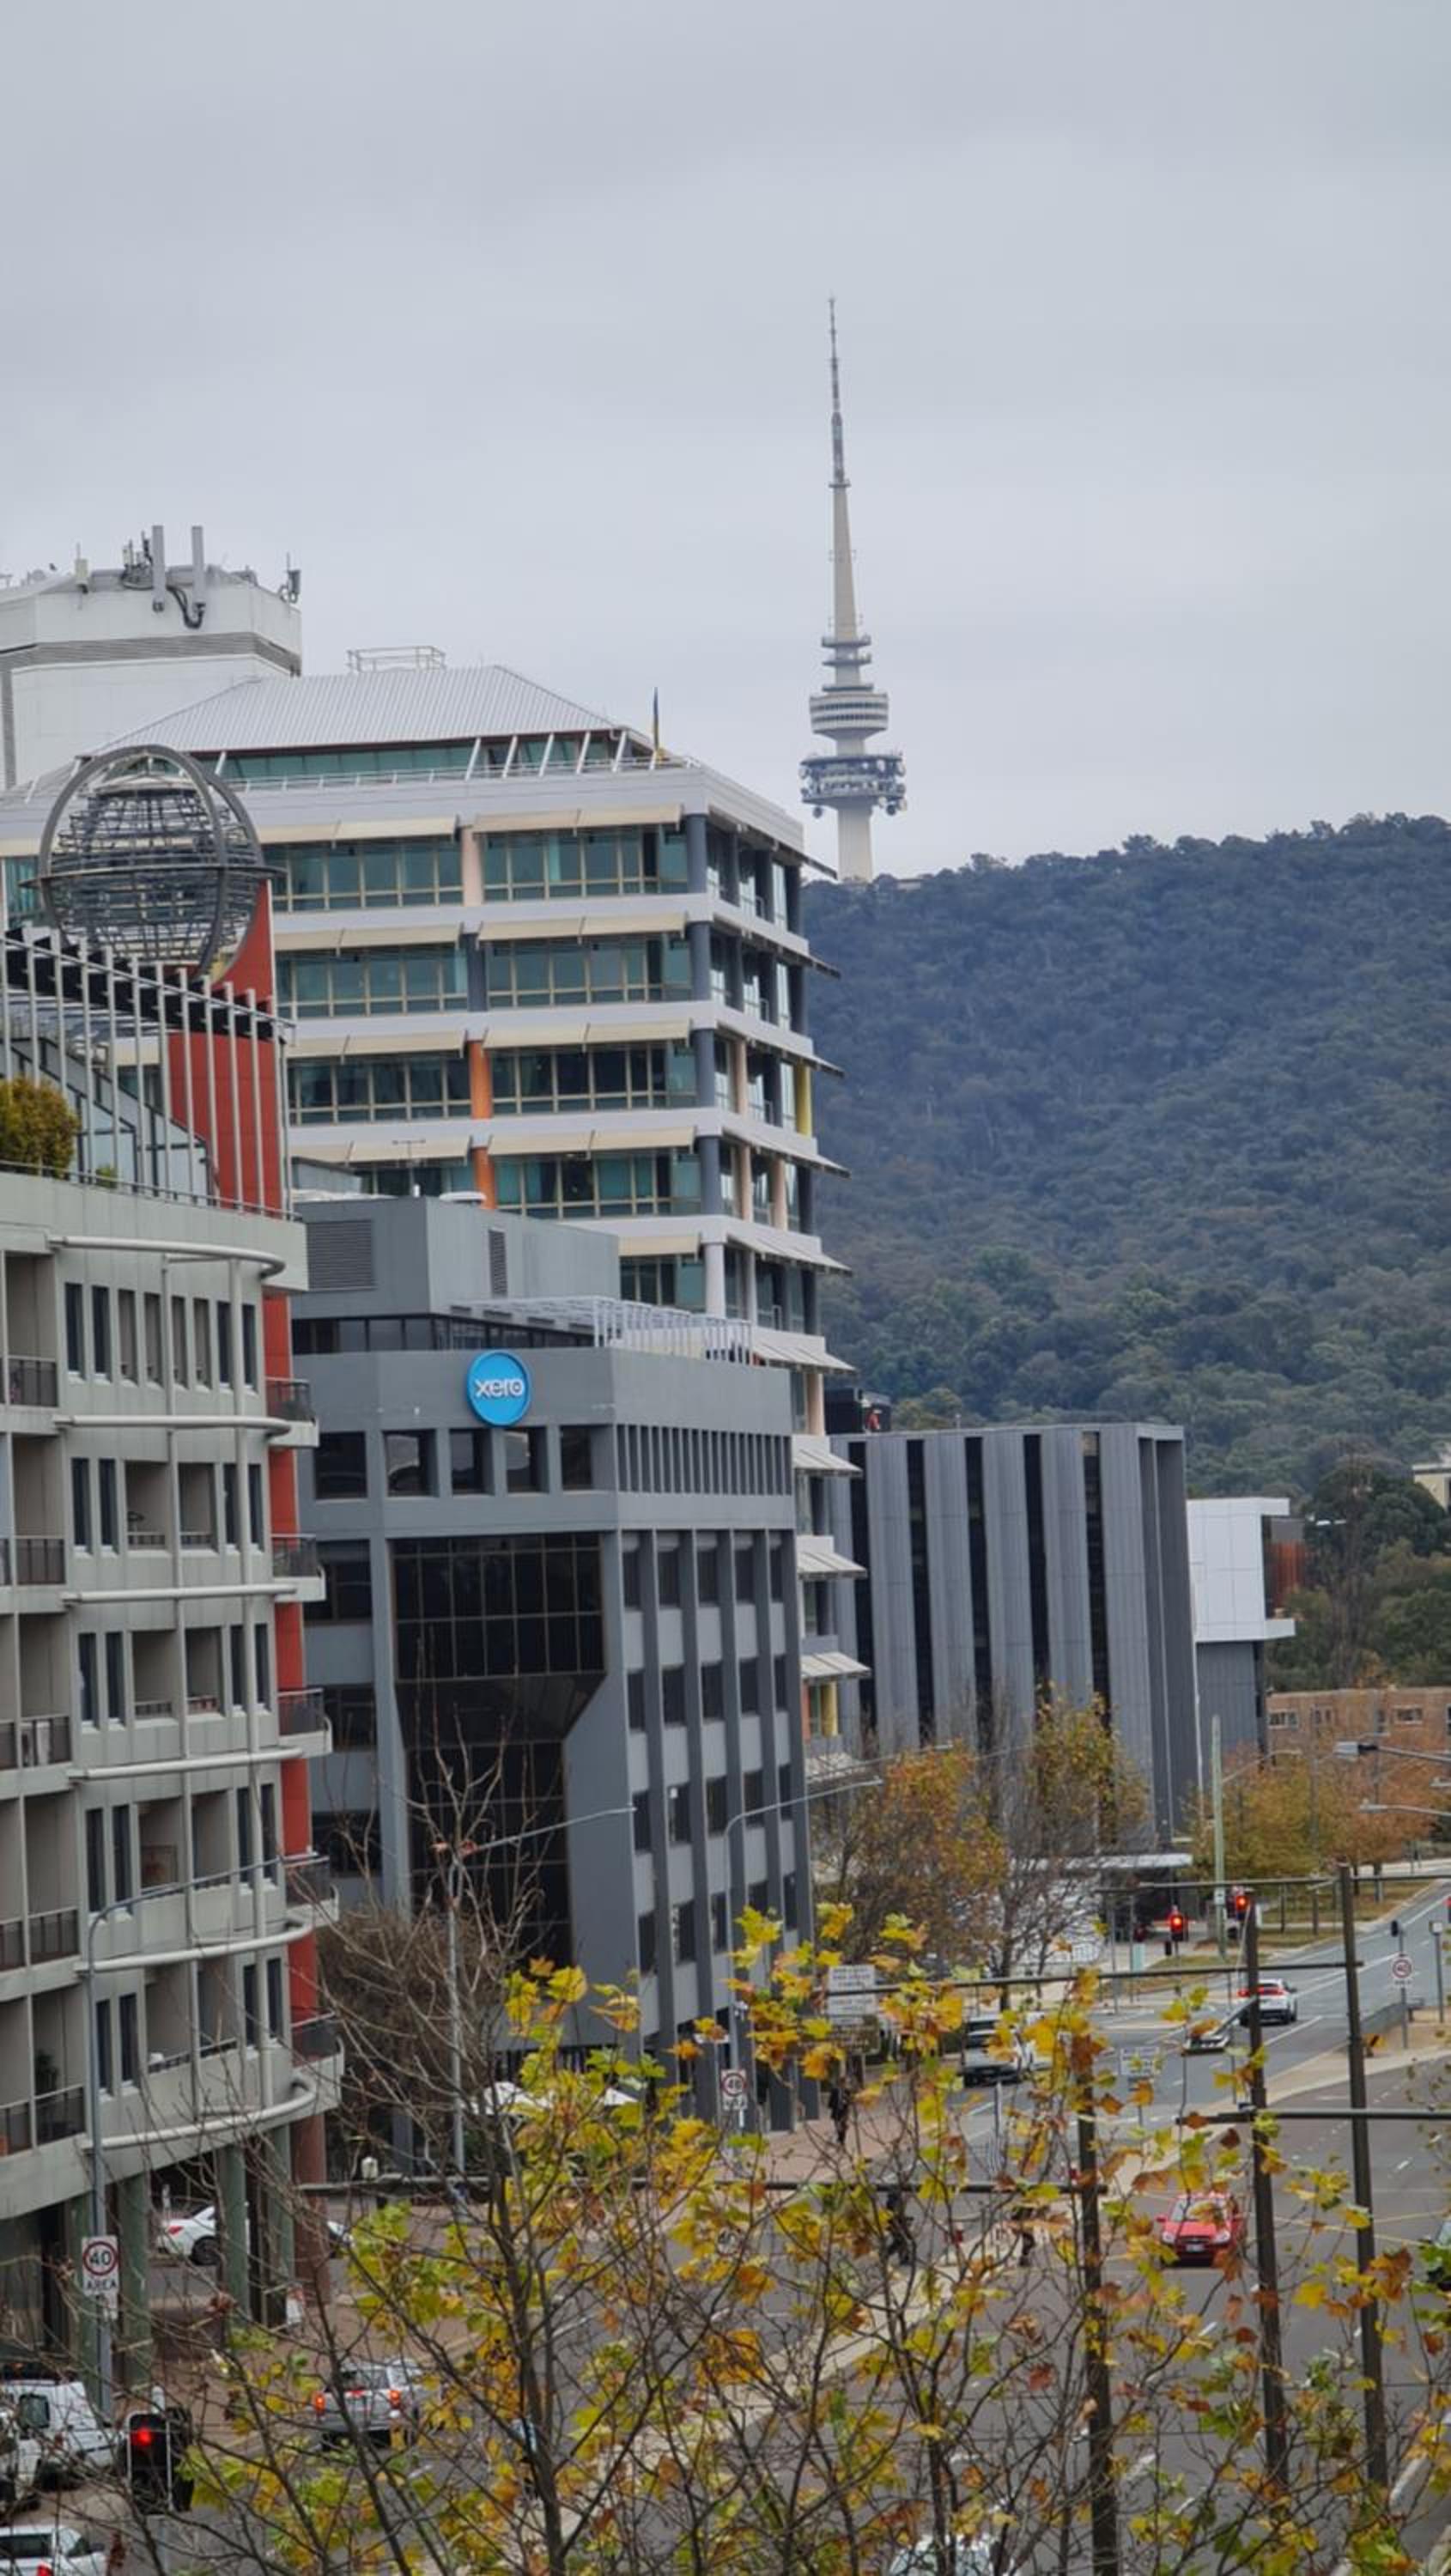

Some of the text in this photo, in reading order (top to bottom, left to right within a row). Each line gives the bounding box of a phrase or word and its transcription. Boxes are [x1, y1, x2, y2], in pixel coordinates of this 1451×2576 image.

[475, 1378, 525, 1398] xero
[90, 2251, 112, 2266] 40
[87, 2280, 117, 2290] AREA
